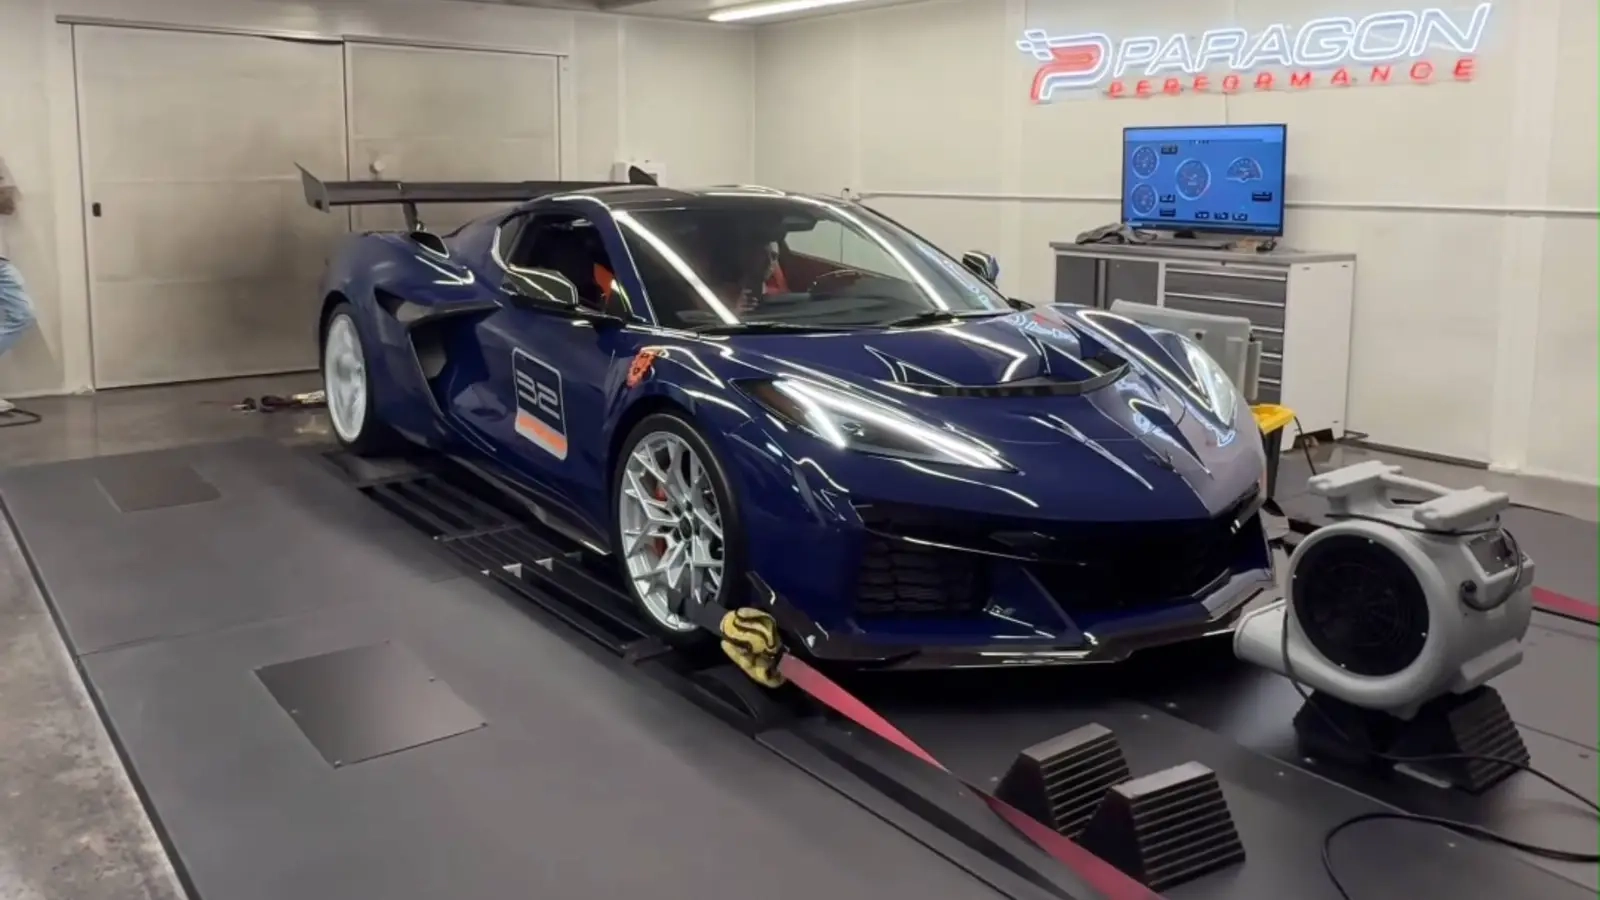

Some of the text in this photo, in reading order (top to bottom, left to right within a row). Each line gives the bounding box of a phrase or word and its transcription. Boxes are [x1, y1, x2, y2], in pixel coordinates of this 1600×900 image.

[1112, 2, 1491, 77] PARAGON
[1108, 58, 1475, 98] PERFORMANCE
[516, 369, 561, 420] 32
